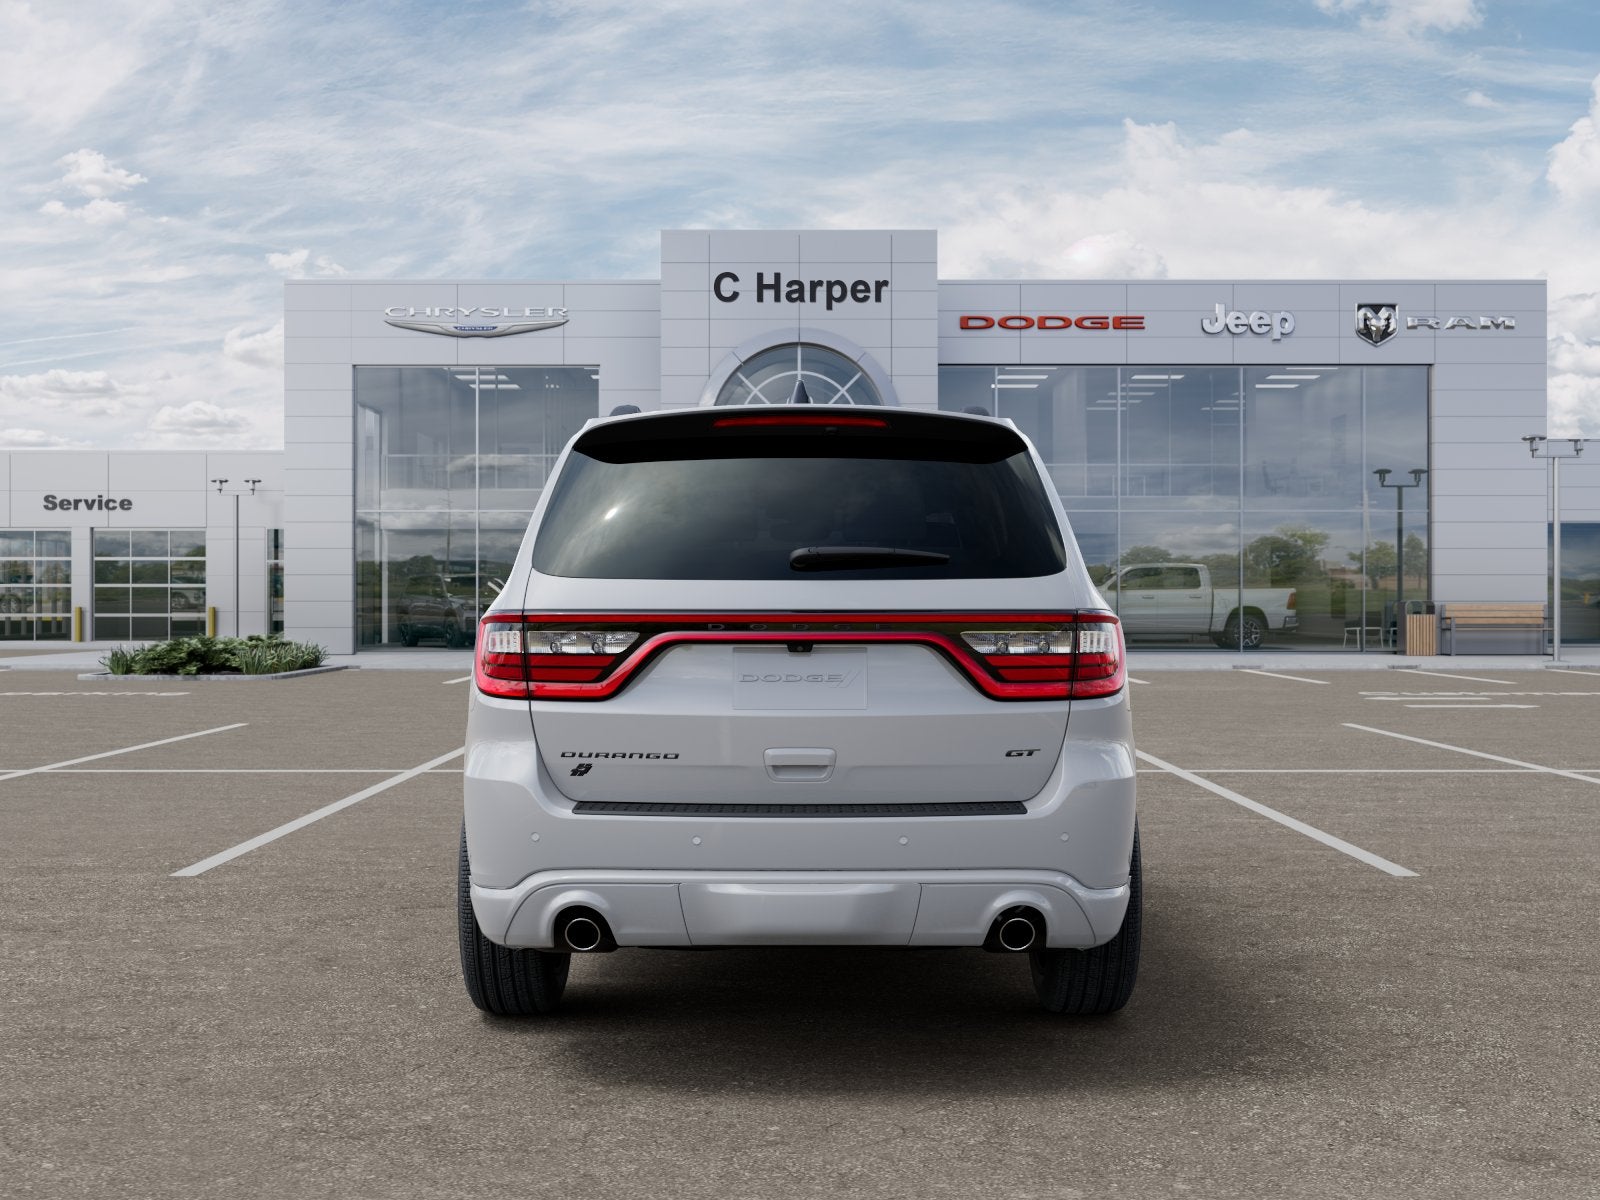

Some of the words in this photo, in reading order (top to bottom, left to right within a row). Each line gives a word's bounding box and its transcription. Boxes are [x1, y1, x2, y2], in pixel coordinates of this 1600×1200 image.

[713, 271, 740, 303] C
[756, 272, 889, 311] Harper
[384, 306, 569, 317] CHRYSLER
[959, 315, 1146, 330] DODGE
[1201, 303, 1295, 341] Jeep
[1406, 315, 1516, 330] RAM
[43, 494, 132, 510] Service
[739, 673, 843, 683] DODGE
[560, 751, 680, 760] DURANGO
[1005, 748, 1041, 757] GT
